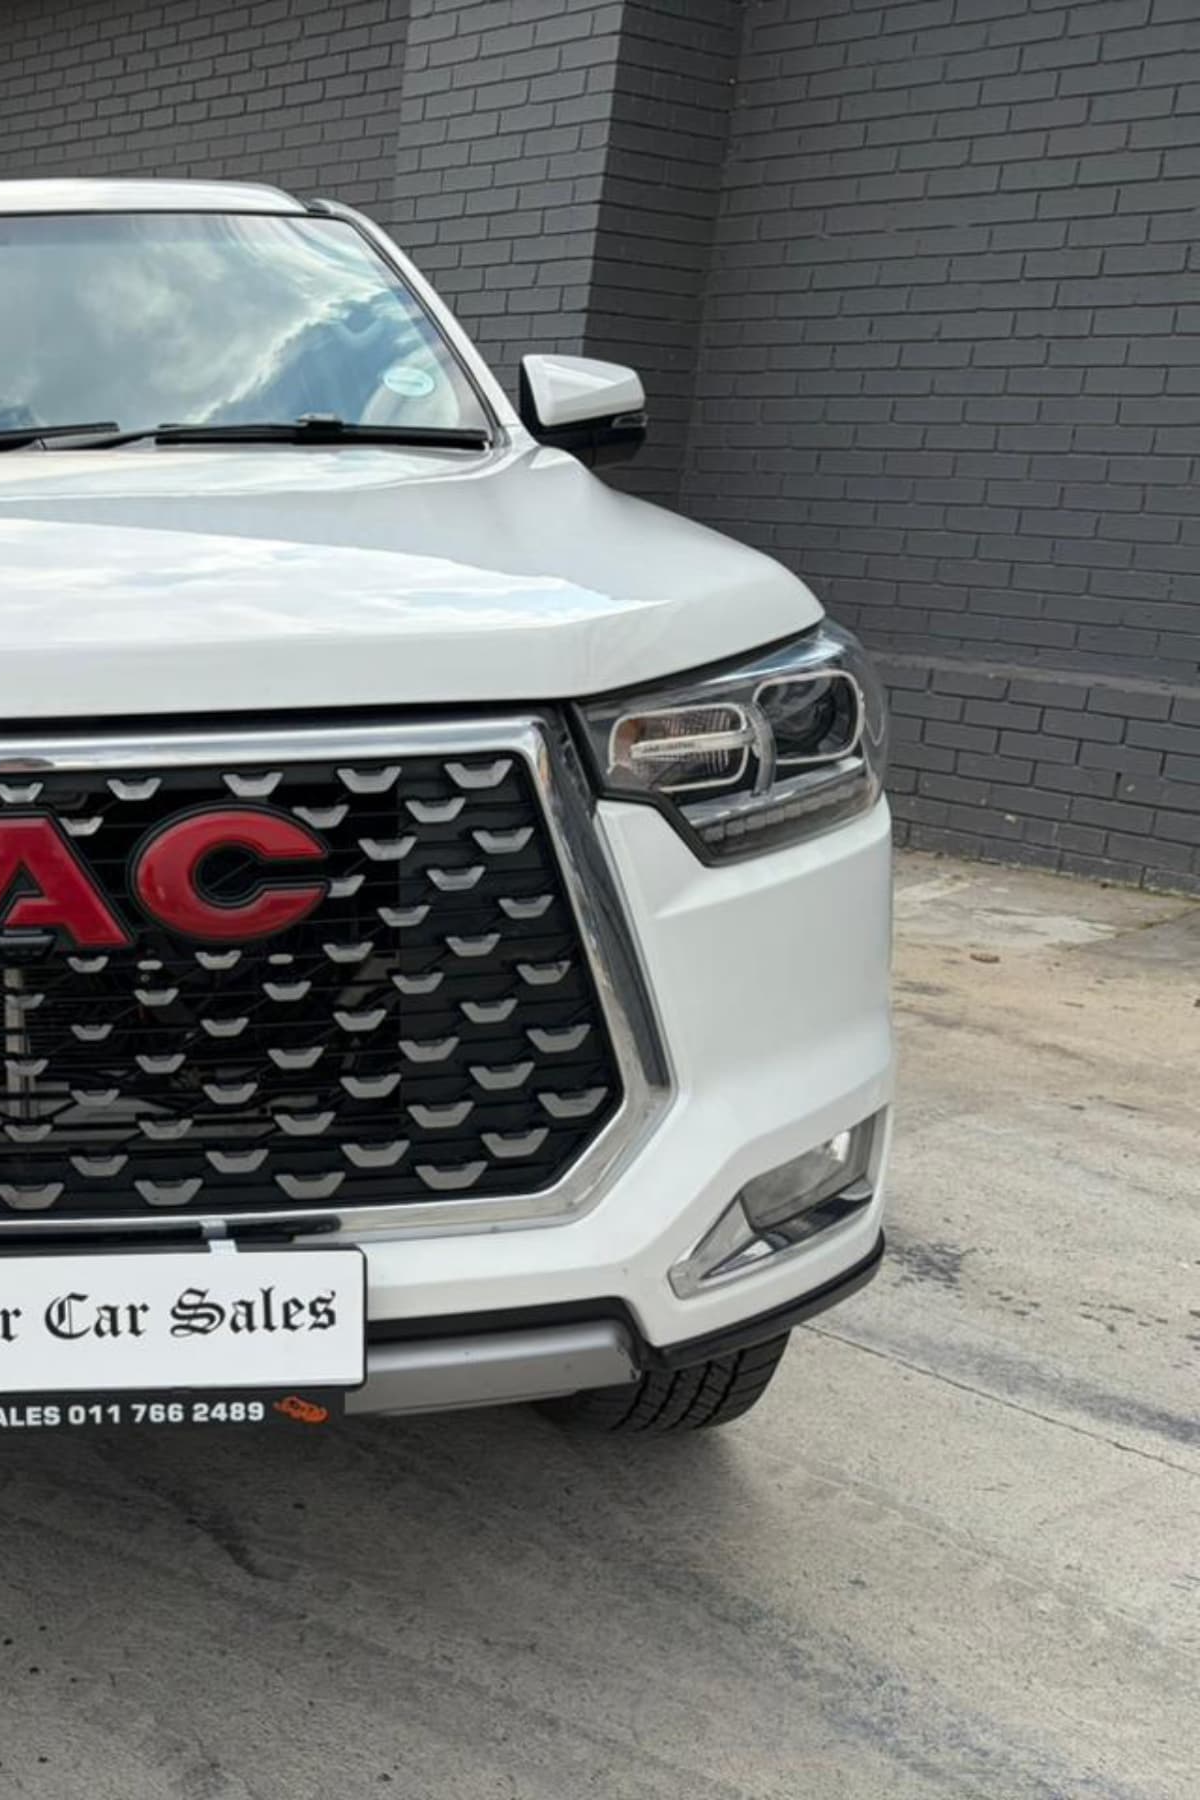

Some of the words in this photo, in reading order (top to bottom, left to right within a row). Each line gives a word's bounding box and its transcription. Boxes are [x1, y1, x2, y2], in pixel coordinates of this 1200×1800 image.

[44, 1292, 149, 1341] Car
[170, 1286, 337, 1336] Sales
[68, 1405, 120, 1425] 011
[131, 1403, 184, 1423] 766
[192, 1401, 264, 1422] 2489
